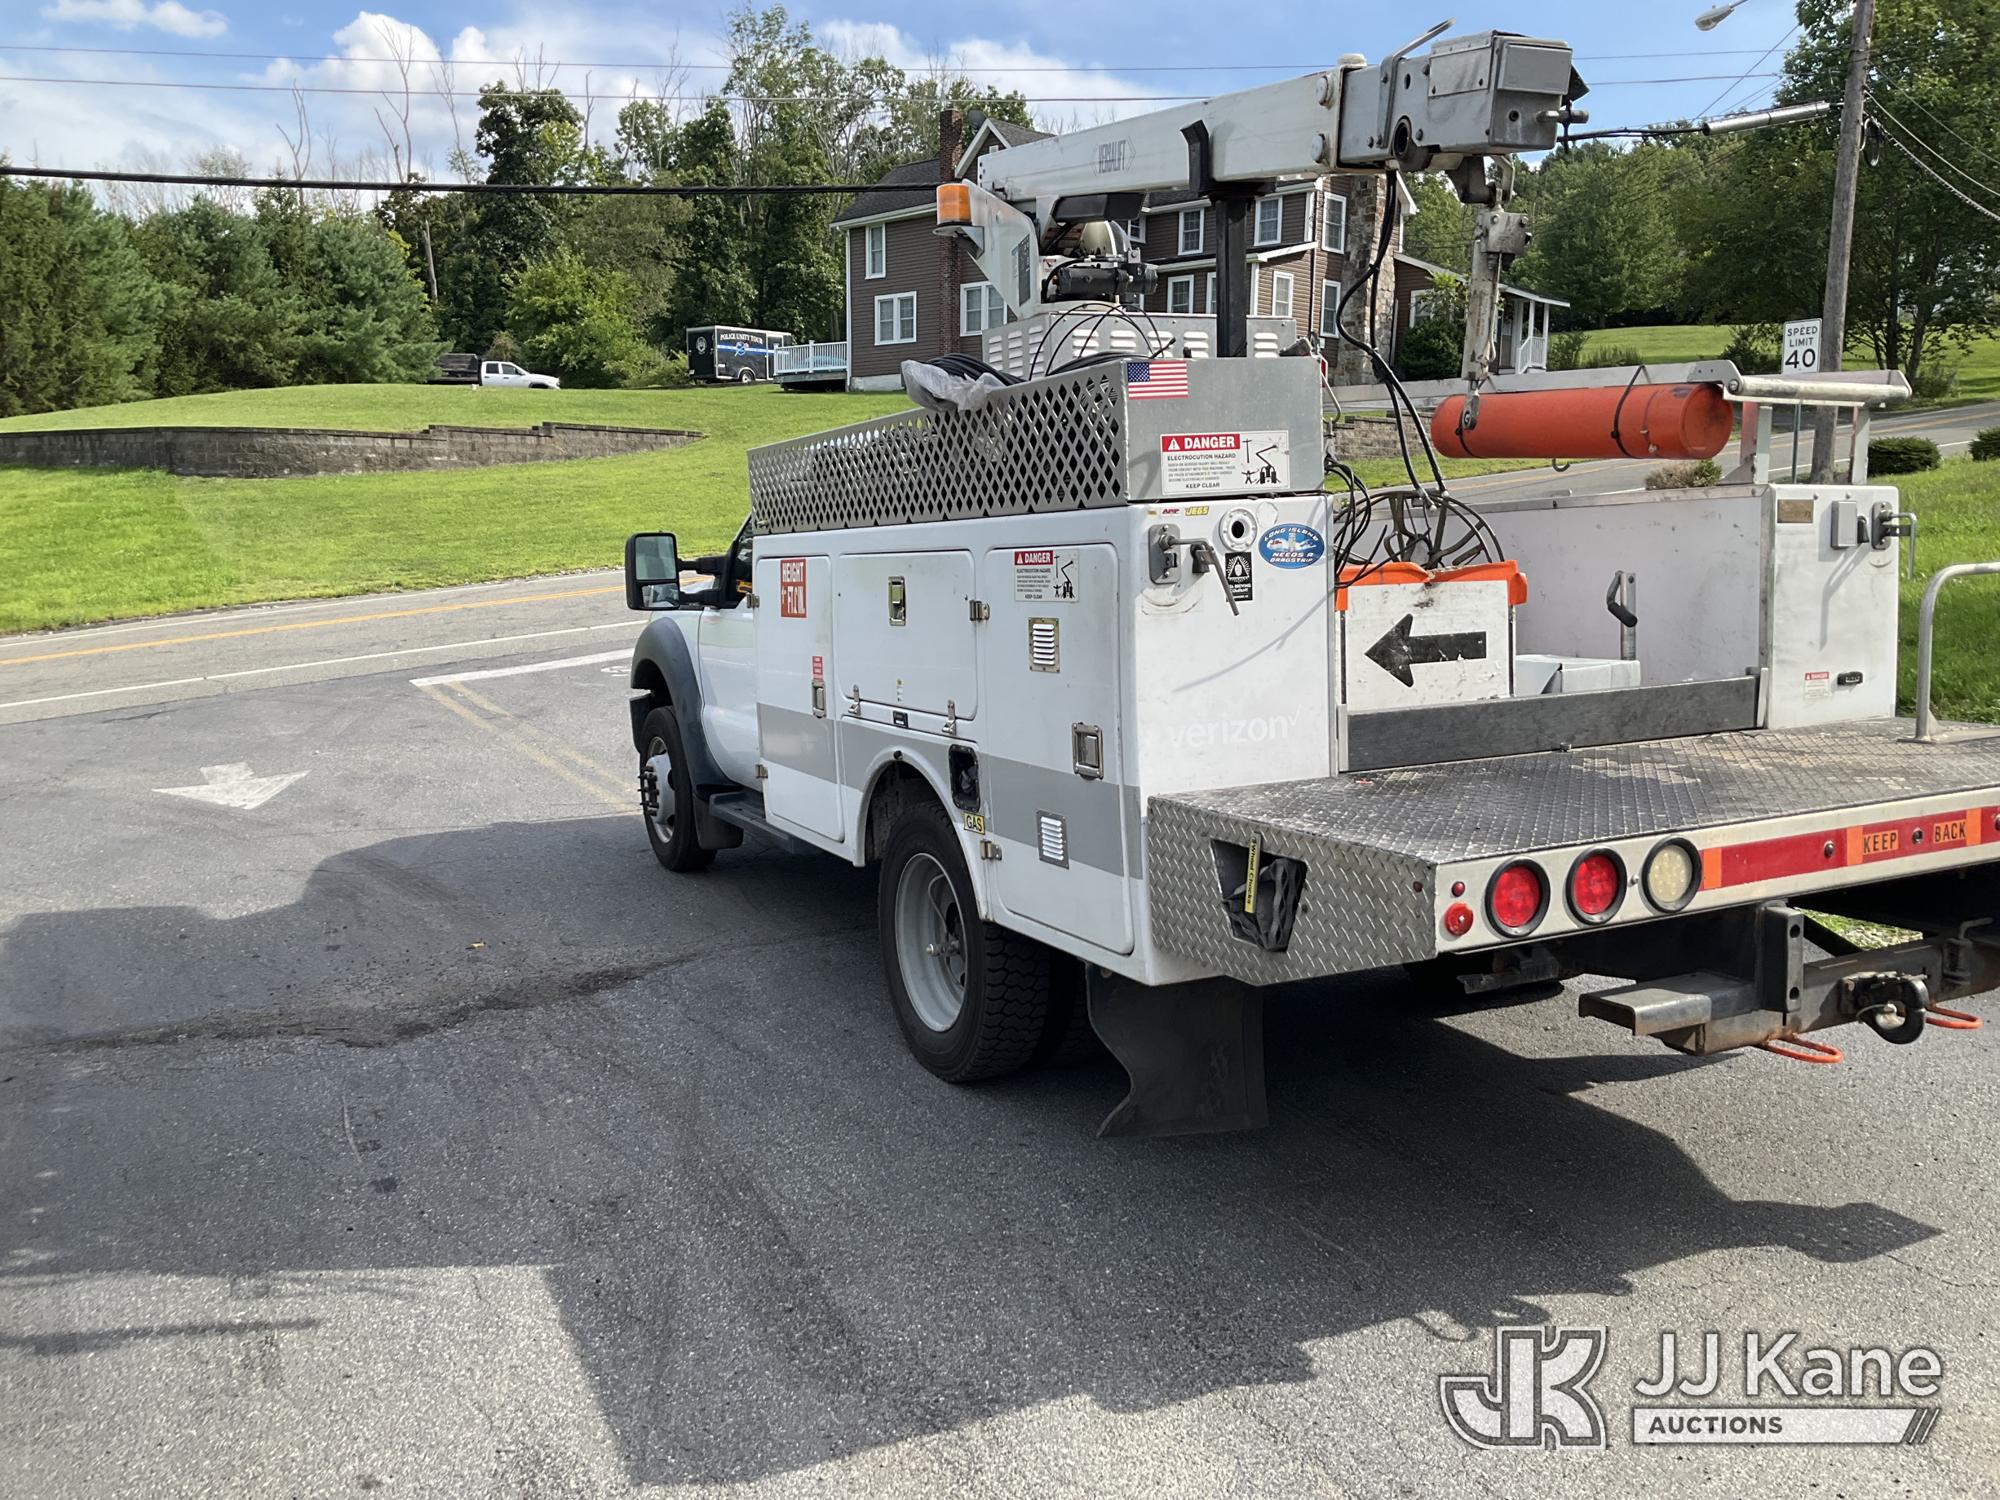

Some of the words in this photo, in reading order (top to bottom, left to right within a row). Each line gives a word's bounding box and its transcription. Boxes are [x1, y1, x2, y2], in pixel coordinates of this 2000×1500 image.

[1787, 326, 1818, 336] SPEED
[1789, 337, 1813, 347] LIMIT
[1785, 348, 1816, 369] 40
[1183, 435, 1236, 450] DANGER
[1167, 453, 1213, 461] ELECTROCUTION
[1214, 452, 1237, 460] HAZARD
[1024, 552, 1051, 564] DANGER
[782, 561, 804, 583] HEIGHT
[966, 814, 983, 832] GAS
[1863, 832, 1897, 854] KEEP
[1934, 821, 1966, 843] BACK
